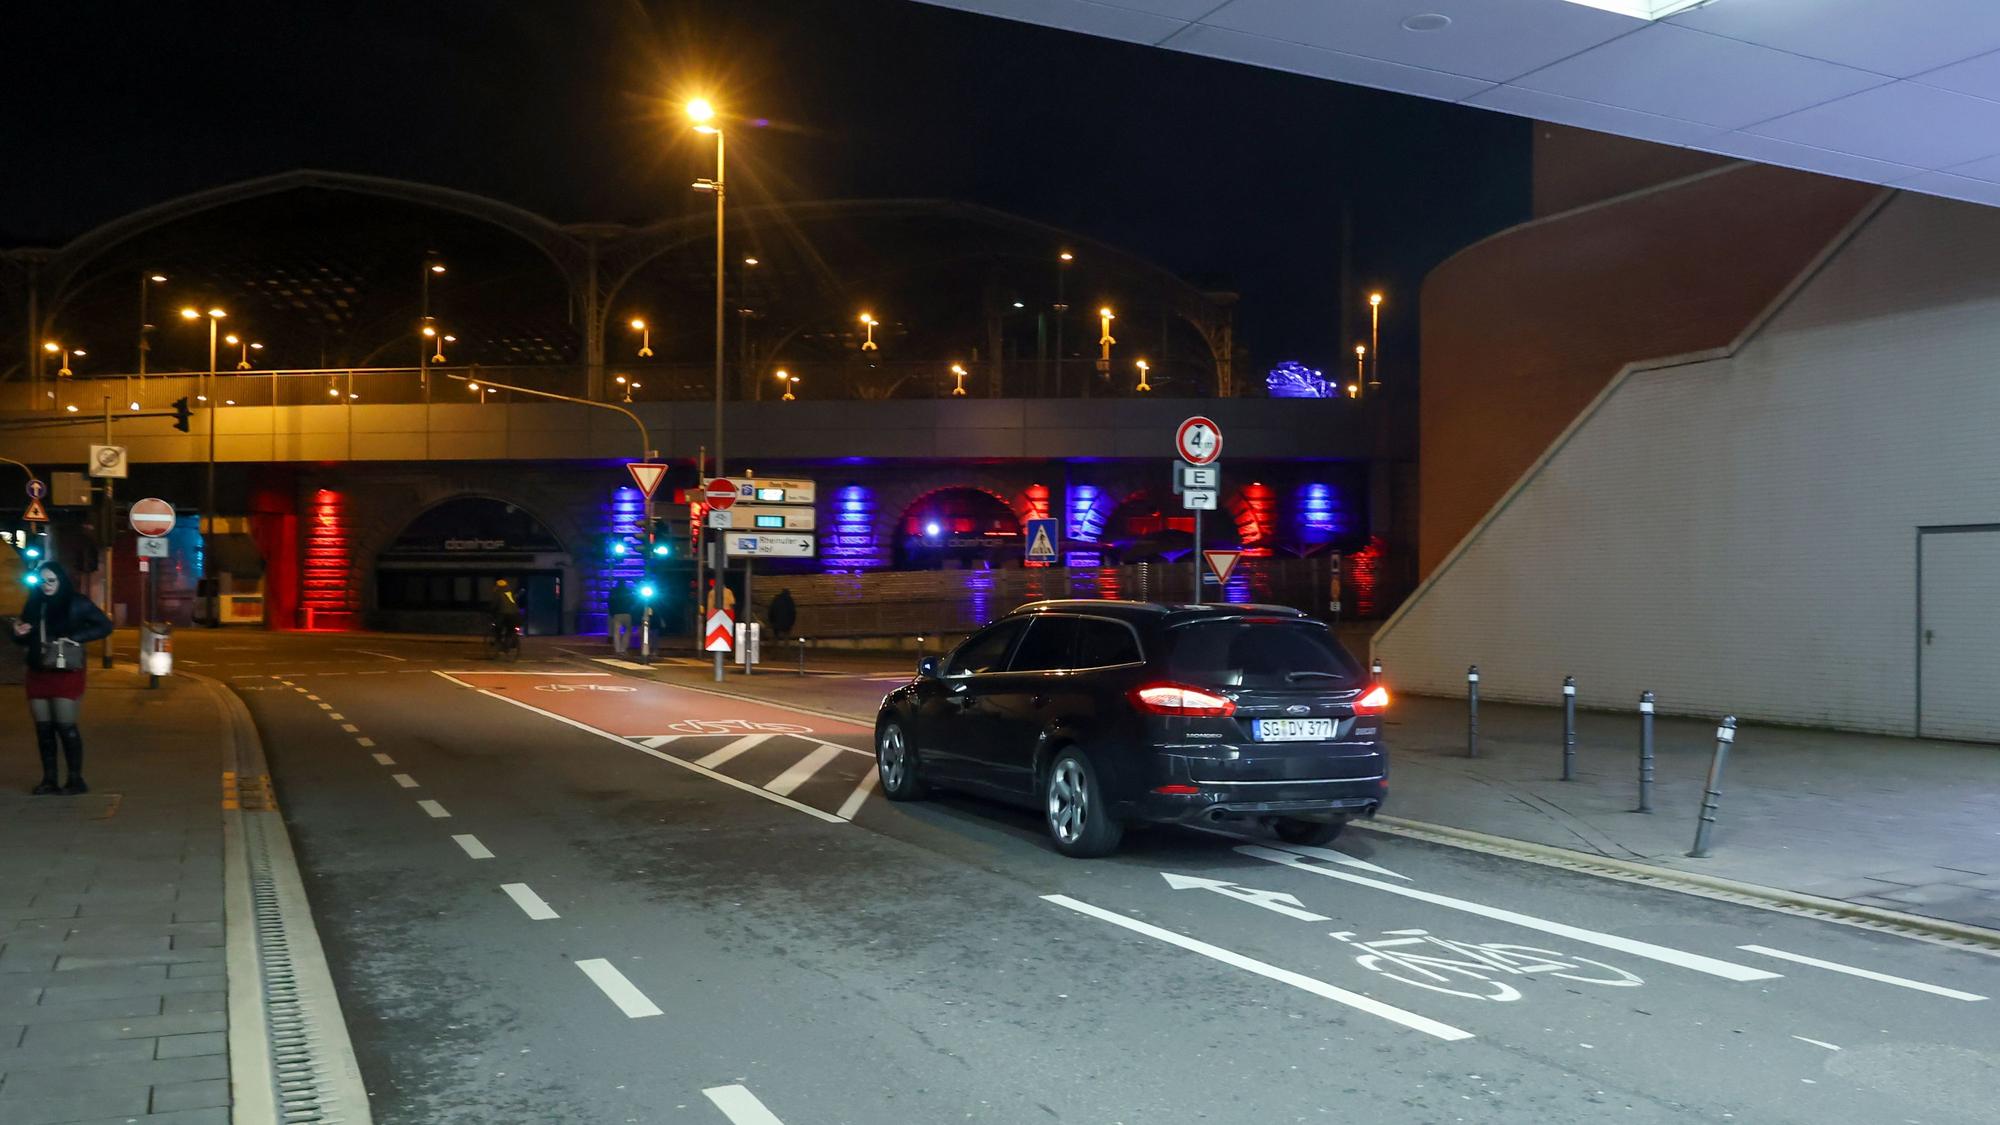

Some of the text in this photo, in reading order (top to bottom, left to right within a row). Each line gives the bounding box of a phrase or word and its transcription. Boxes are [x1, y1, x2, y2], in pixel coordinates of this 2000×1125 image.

[1191, 431, 1201, 448] 4
[1194, 471, 1206, 484] E
[1263, 720, 1329, 736] SG DY 377
